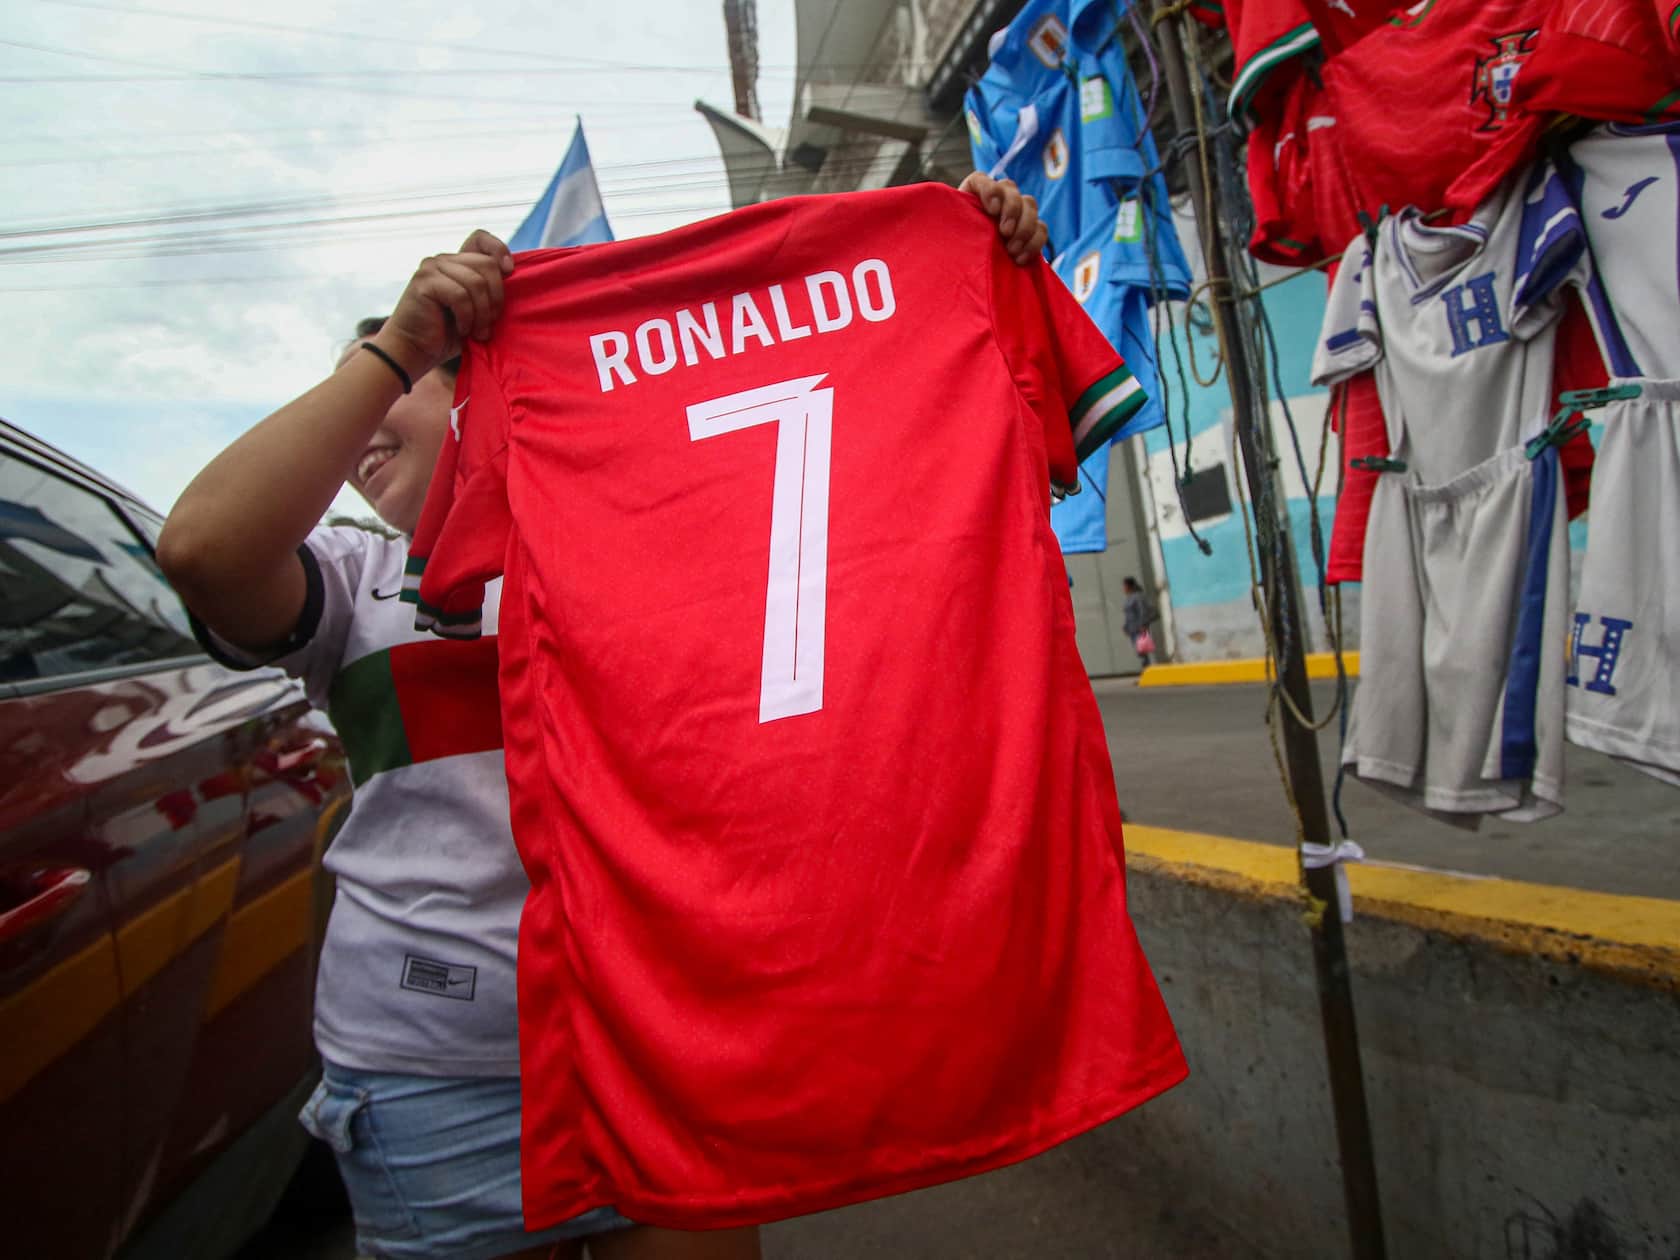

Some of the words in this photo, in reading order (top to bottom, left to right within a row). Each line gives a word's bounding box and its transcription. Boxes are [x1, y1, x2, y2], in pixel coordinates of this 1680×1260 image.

[589, 258, 896, 393] RONALDO
[1441, 272, 1510, 358] H
[685, 372, 834, 724] 7
[1566, 613, 1633, 695] H
